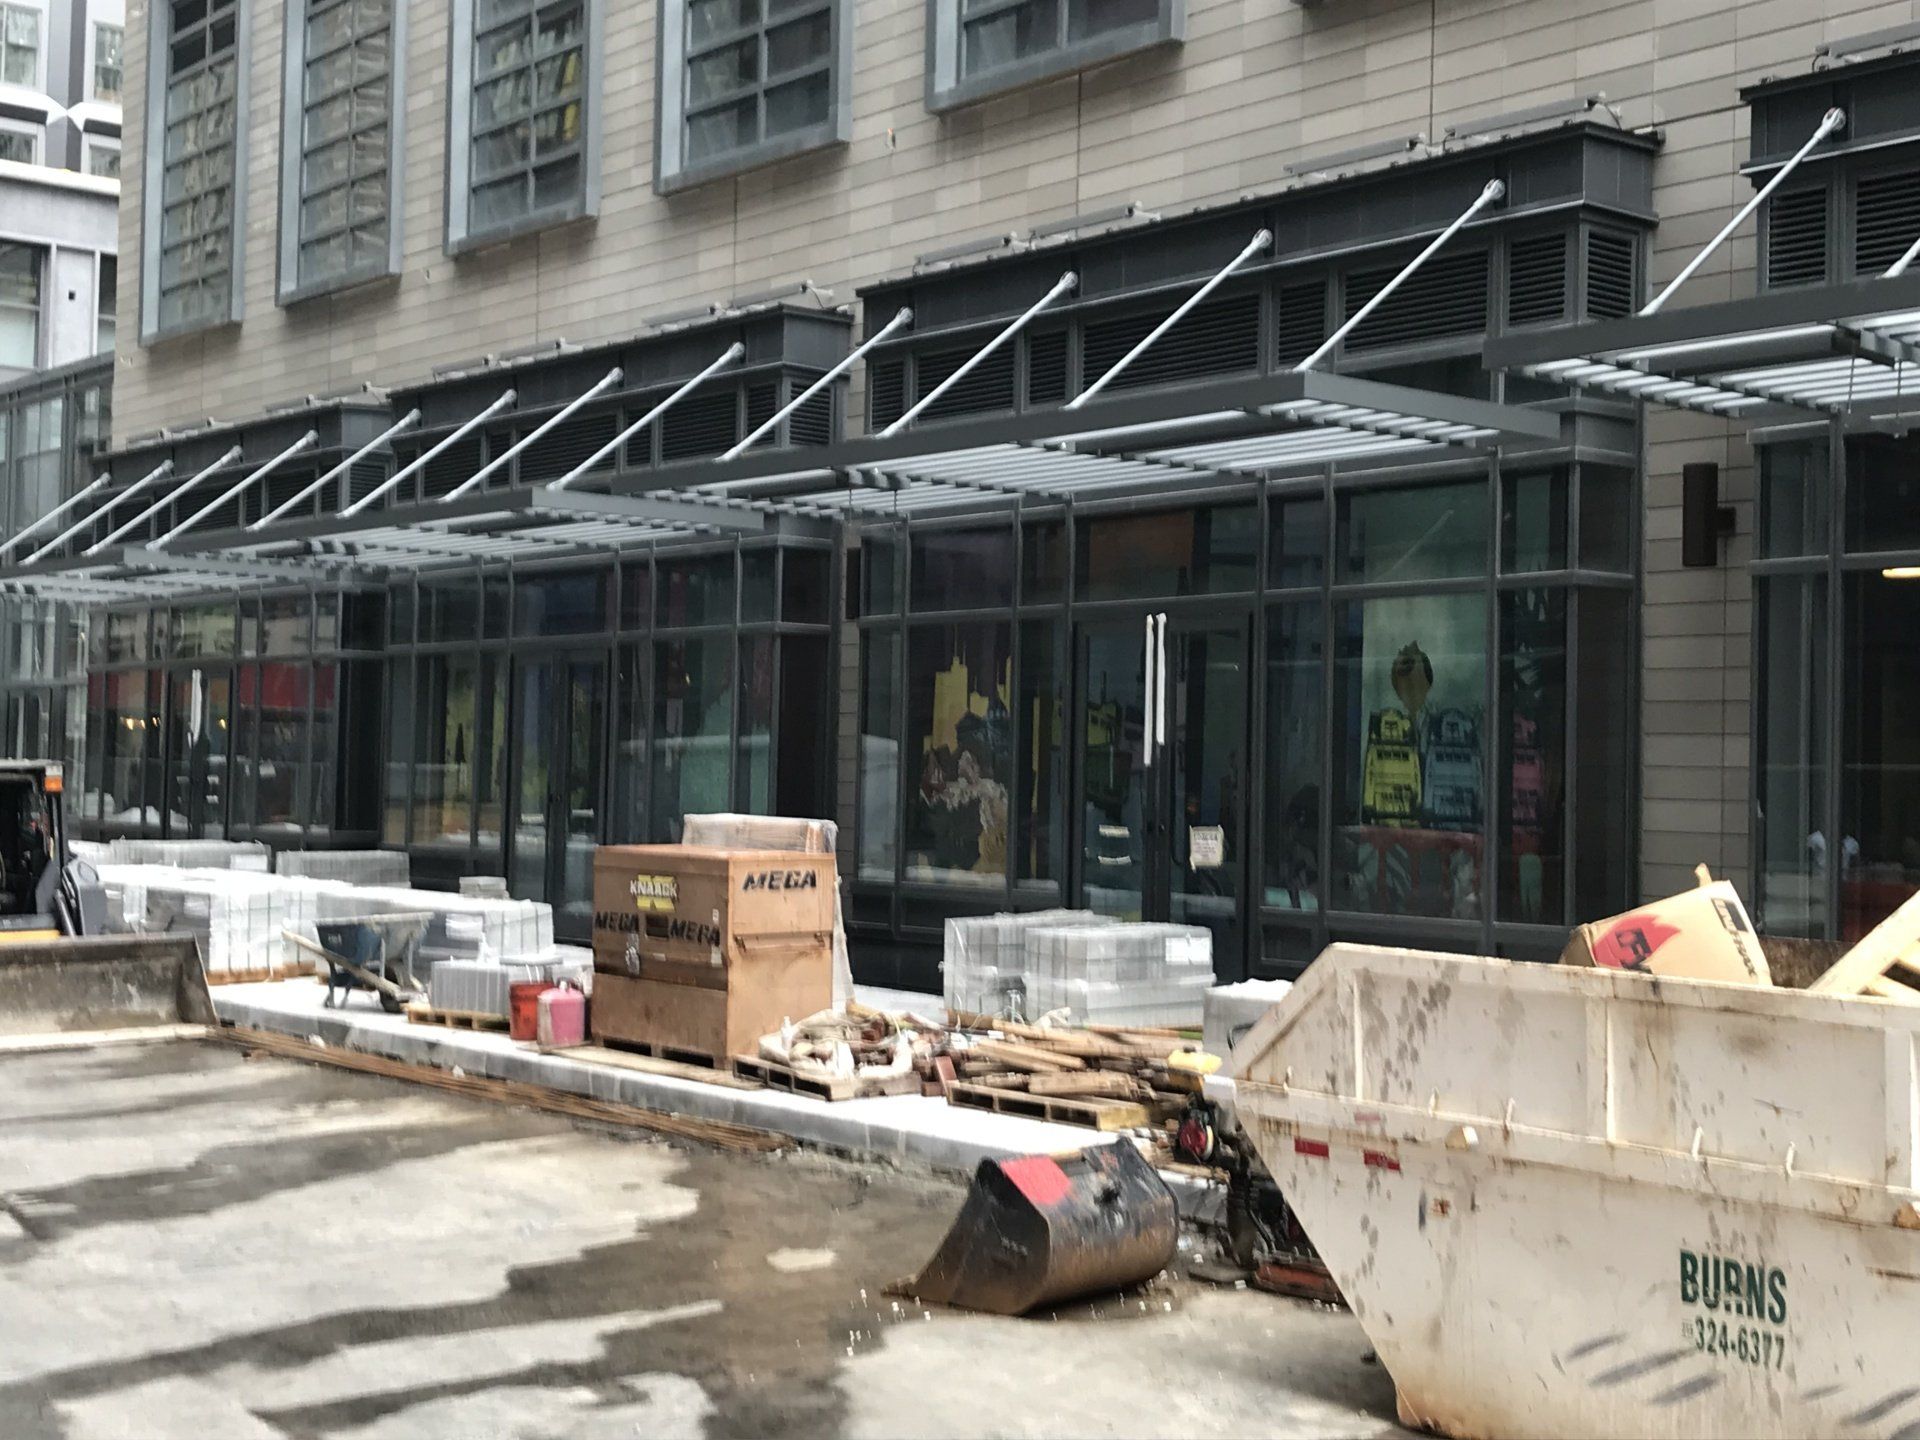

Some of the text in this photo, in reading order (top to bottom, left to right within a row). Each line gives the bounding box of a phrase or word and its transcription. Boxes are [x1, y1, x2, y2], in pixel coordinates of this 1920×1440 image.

[630, 880, 678, 898] KNAACK
[742, 869, 817, 891] MEGA
[595, 911, 640, 932] MEGA
[1680, 1250, 1786, 1324] BURNS
